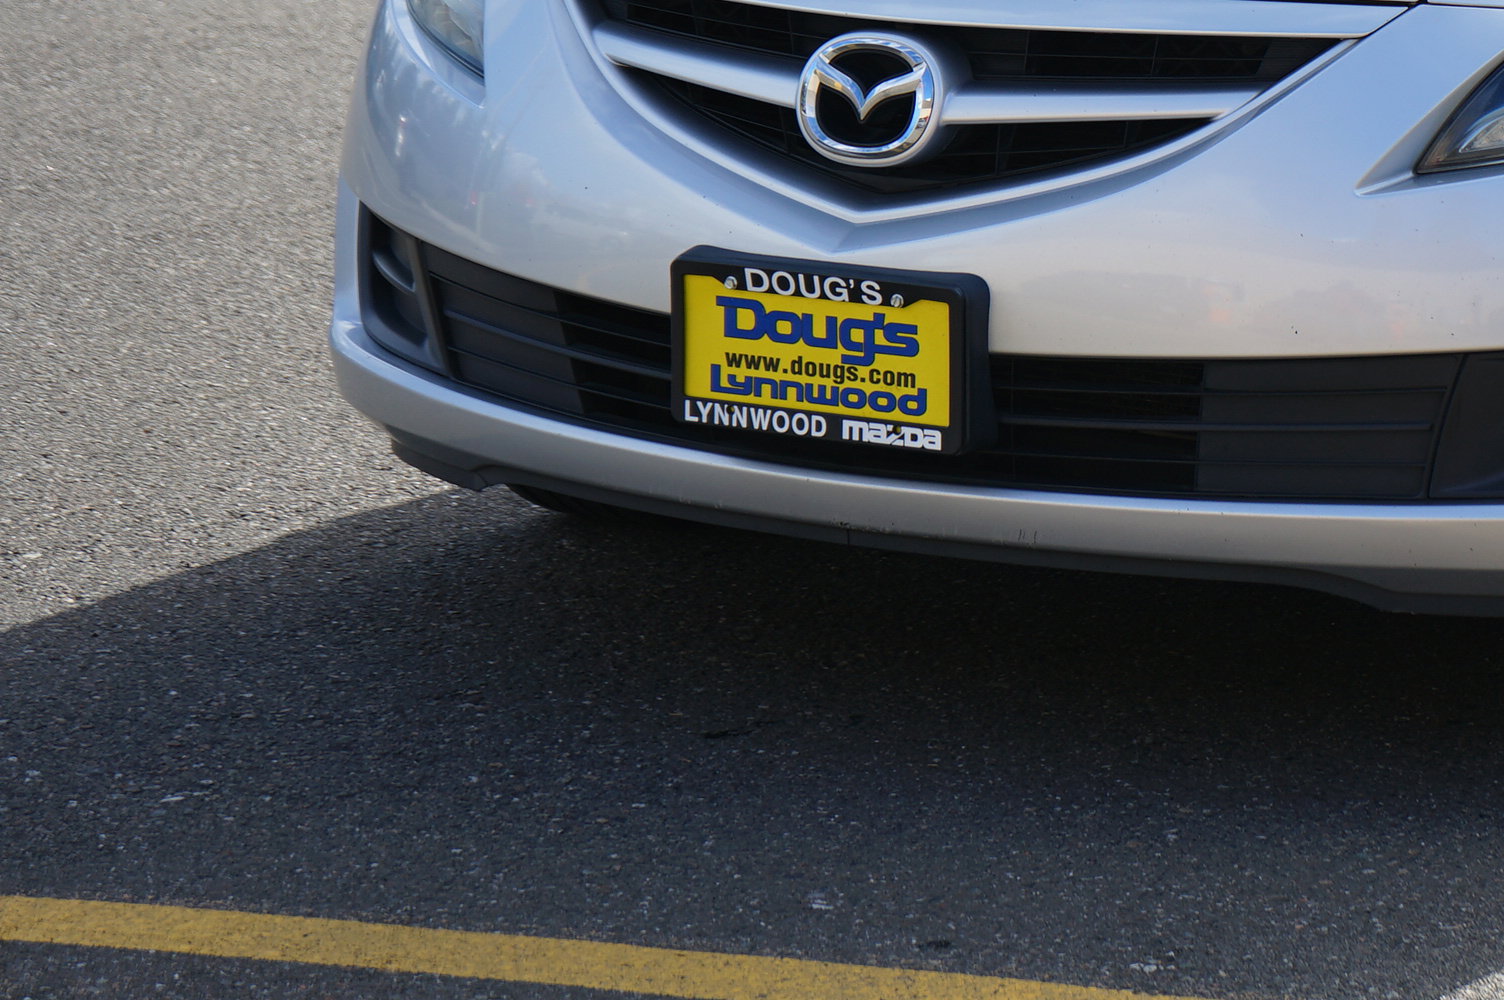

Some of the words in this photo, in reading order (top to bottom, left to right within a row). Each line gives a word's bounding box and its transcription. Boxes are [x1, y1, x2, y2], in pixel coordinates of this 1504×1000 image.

[744, 267, 884, 306] DOUG'S
[716, 295, 920, 367] Doug's
[710, 363, 928, 417] Lynnwood
[725, 352, 917, 389] www.dougs.com
[684, 399, 827, 438] LYNNWOOD
